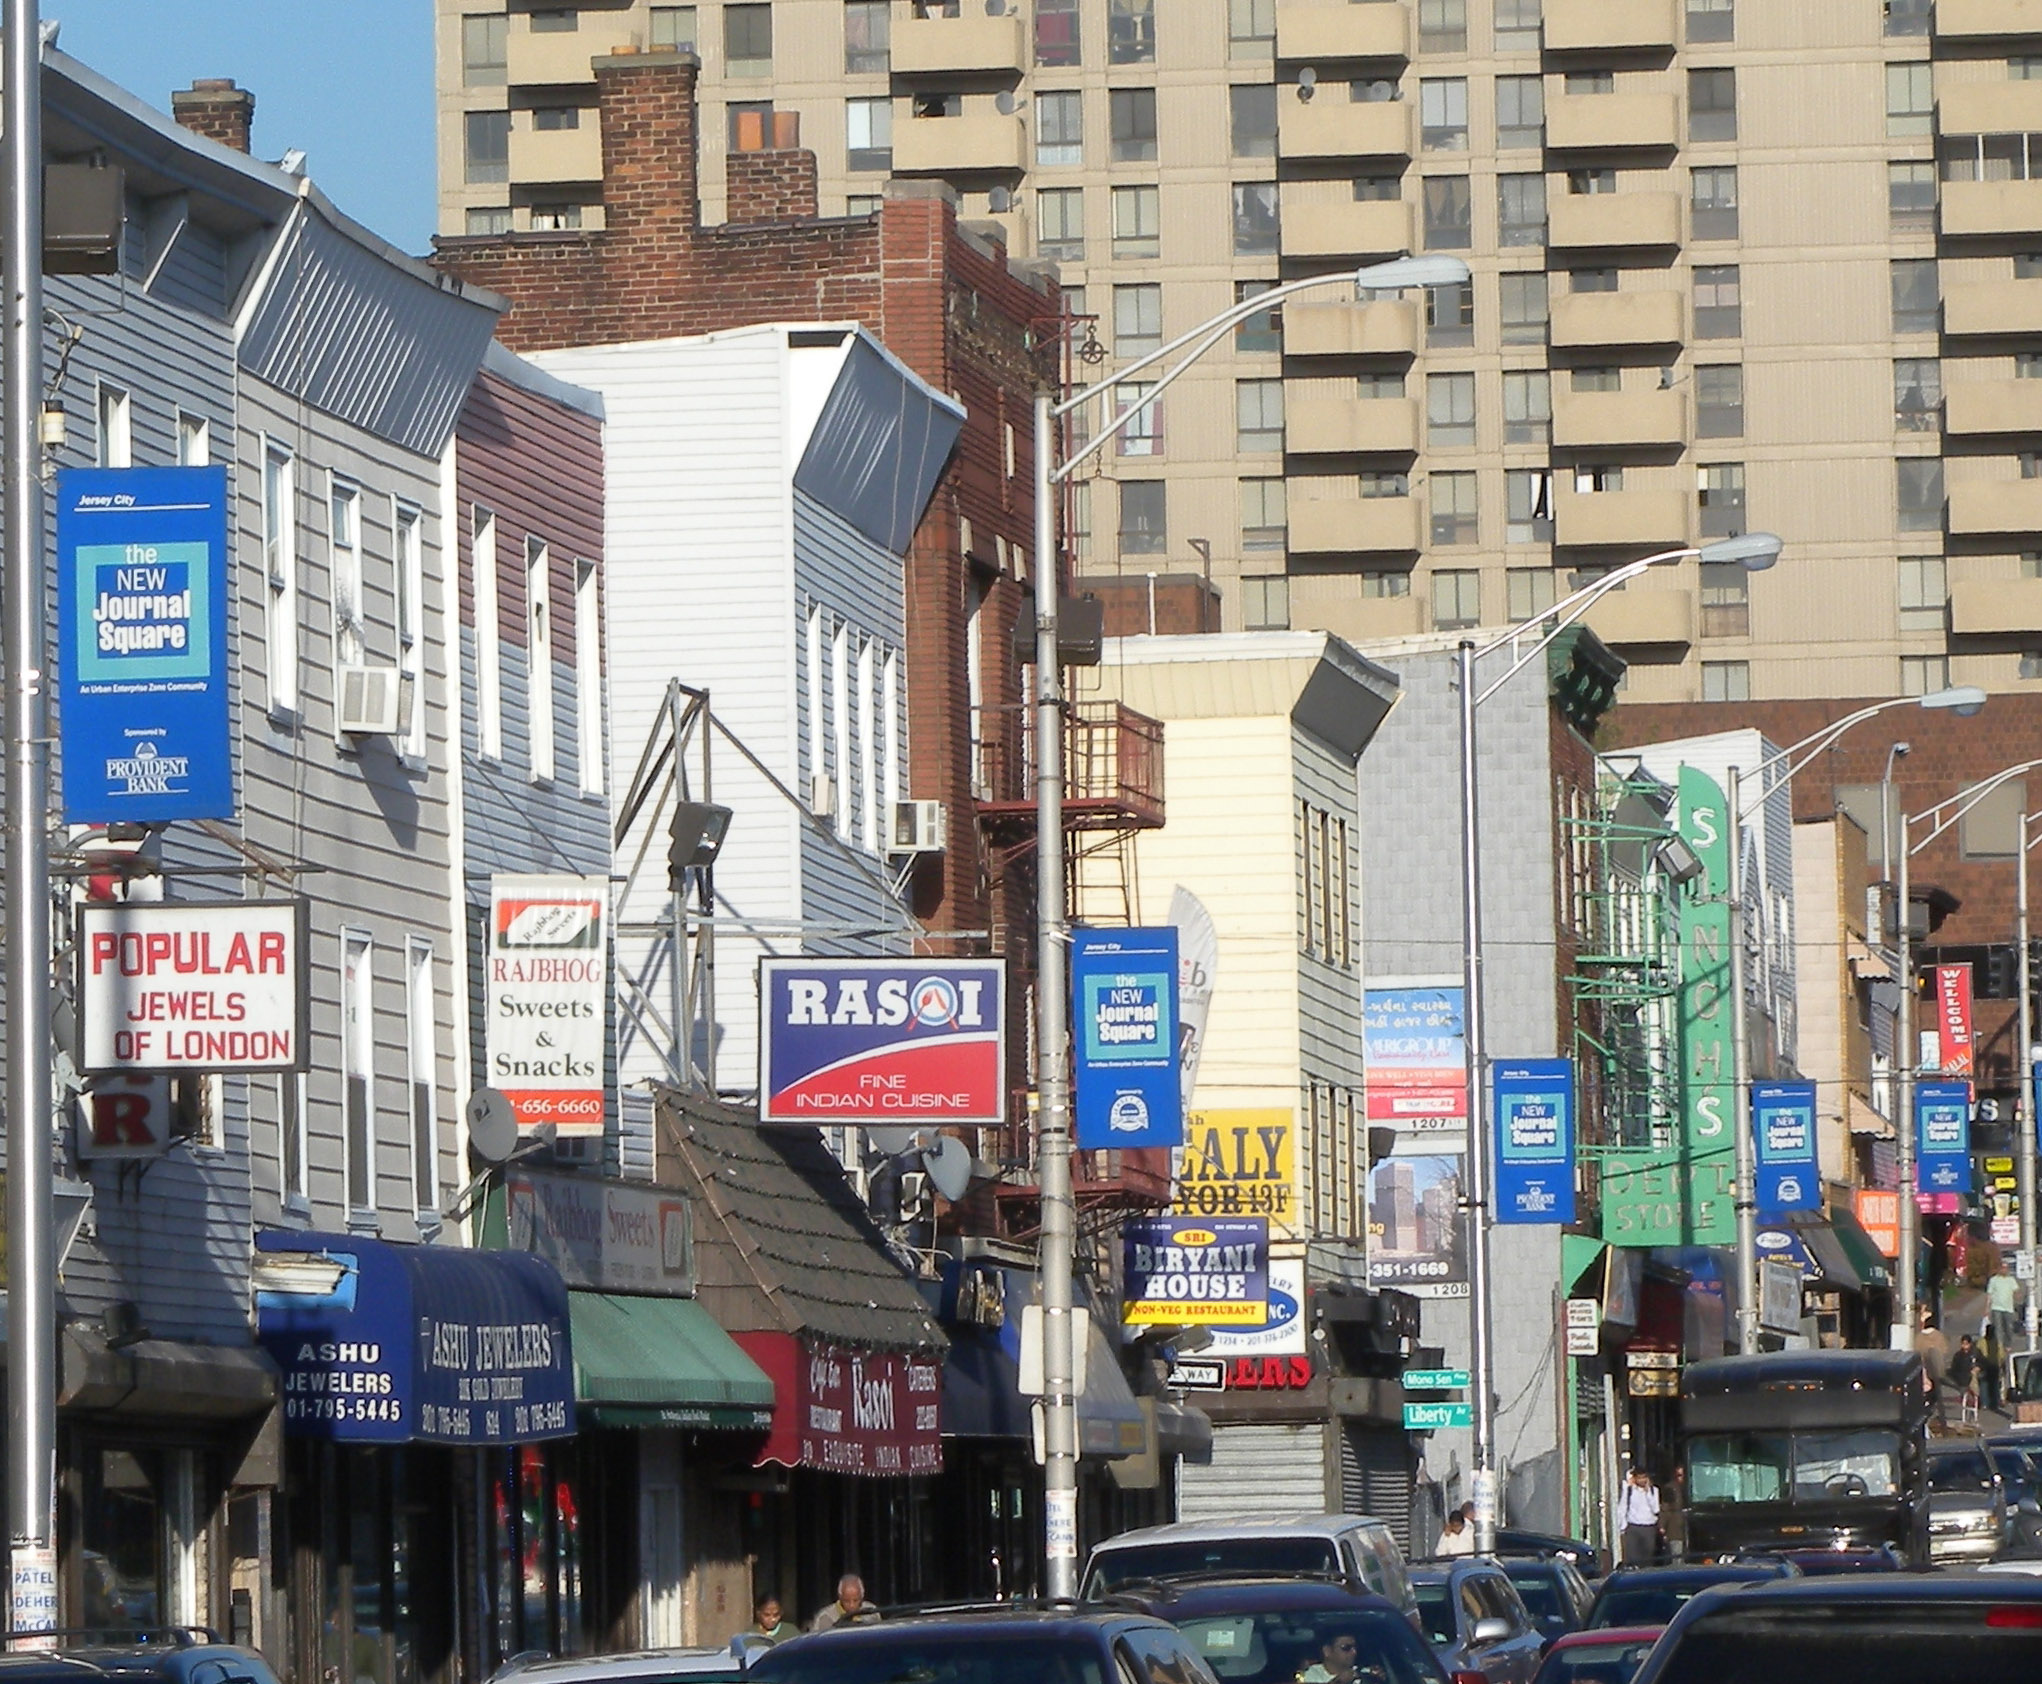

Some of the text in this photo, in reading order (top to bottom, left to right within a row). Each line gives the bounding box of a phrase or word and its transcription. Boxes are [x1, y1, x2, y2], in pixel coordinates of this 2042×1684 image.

[79, 494, 135, 506] Jersey City
[125, 543, 158, 565] the
[117, 567, 167, 591] NEW
[92, 589, 191, 621] Journal
[98, 620, 185, 655] Square
[113, 683, 148, 693] Enterprise
[167, 682, 208, 691] Community
[107, 760, 189, 778] PROVIDENT
[127, 777, 169, 793] BANK
[523, 907, 562, 941] Rajbhog
[92, 931, 286, 977] POPULAR
[493, 958, 601, 983] RAJBHOG
[1115, 974, 1137, 988] the
[126, 990, 247, 1022] JEWELS
[499, 994, 594, 1018] Sweets
[788, 976, 983, 1027] RASOI
[1111, 989, 1143, 1005] NEW
[1095, 1002, 1159, 1023] Journal
[535, 1030, 556, 1048] &
[1099, 1021, 1156, 1044] Square
[114, 1029, 290, 1061] OF LONDON
[495, 1053, 596, 1078] Snacks
[860, 1074, 907, 1089] FINE
[796, 1093, 970, 1108] INDIAN CUISINE
[1521, 1105, 1546, 1116] NEW
[1411, 1118, 1447, 1129] 1207
[1510, 1116, 1558, 1132] Journal
[1775, 1116, 1796, 1127] NEW
[1512, 1131, 1556, 1146] Square
[606, 1188, 657, 1249] Sweets
[1184, 1233, 1206, 1242] SRI
[1145, 1273, 1246, 1300] HOUSE
[1433, 1284, 1469, 1296] 1208
[1134, 1304, 1257, 1316] NON-VEG RESTAURANT
[297, 1342, 380, 1364] ASHU
[432, 1321, 552, 1372] ASHU JEWELERS
[285, 1371, 392, 1395] JEWELERS
[1187, 1369, 1213, 1380] WAY
[852, 1356, 895, 1430] Rasoi
[286, 1398, 401, 1422] 01-795-5445
[1408, 1406, 1452, 1426] Liberty
[15, 1571, 54, 1584] PATEL
